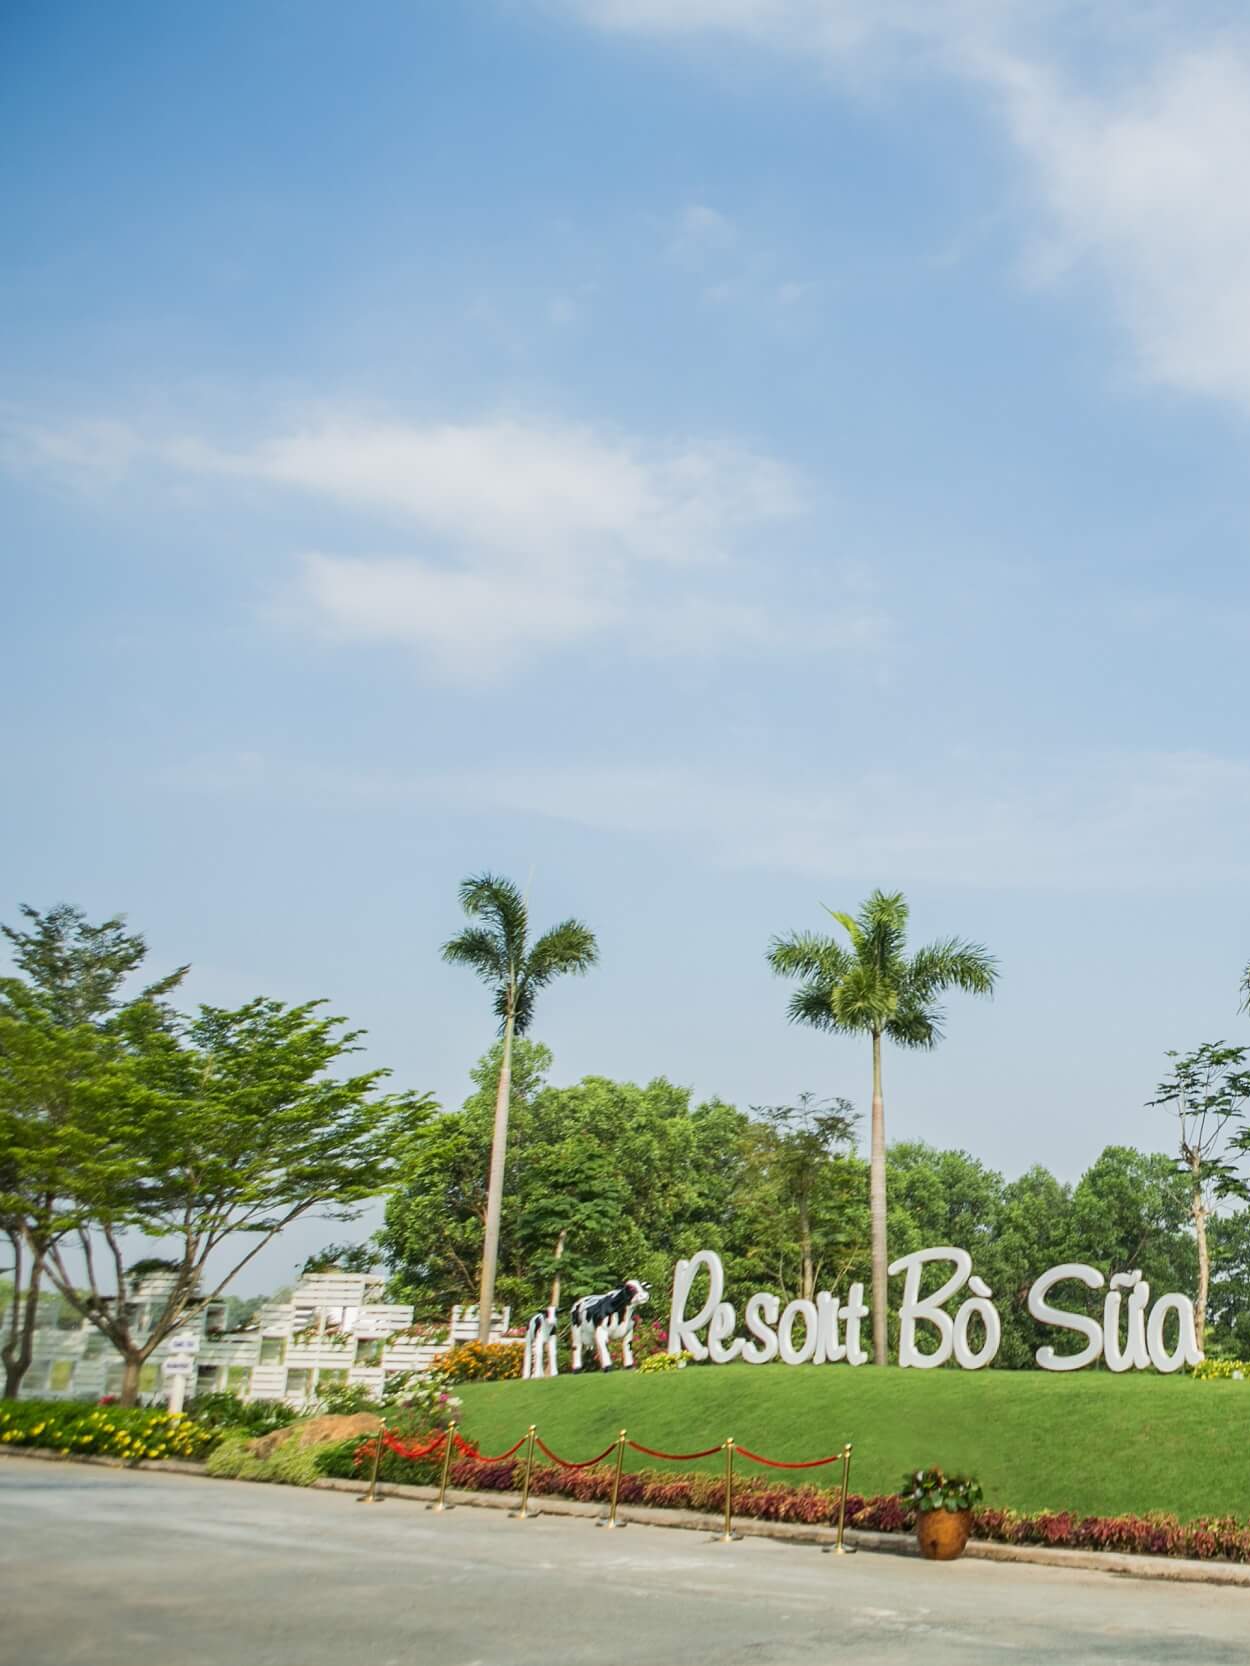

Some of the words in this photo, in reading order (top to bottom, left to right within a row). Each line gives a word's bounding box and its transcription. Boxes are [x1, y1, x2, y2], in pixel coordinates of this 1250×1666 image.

[668, 1250, 869, 1366] Resort
[888, 1247, 1001, 1369] Bò
[1028, 1263, 1204, 1373] Sữa
